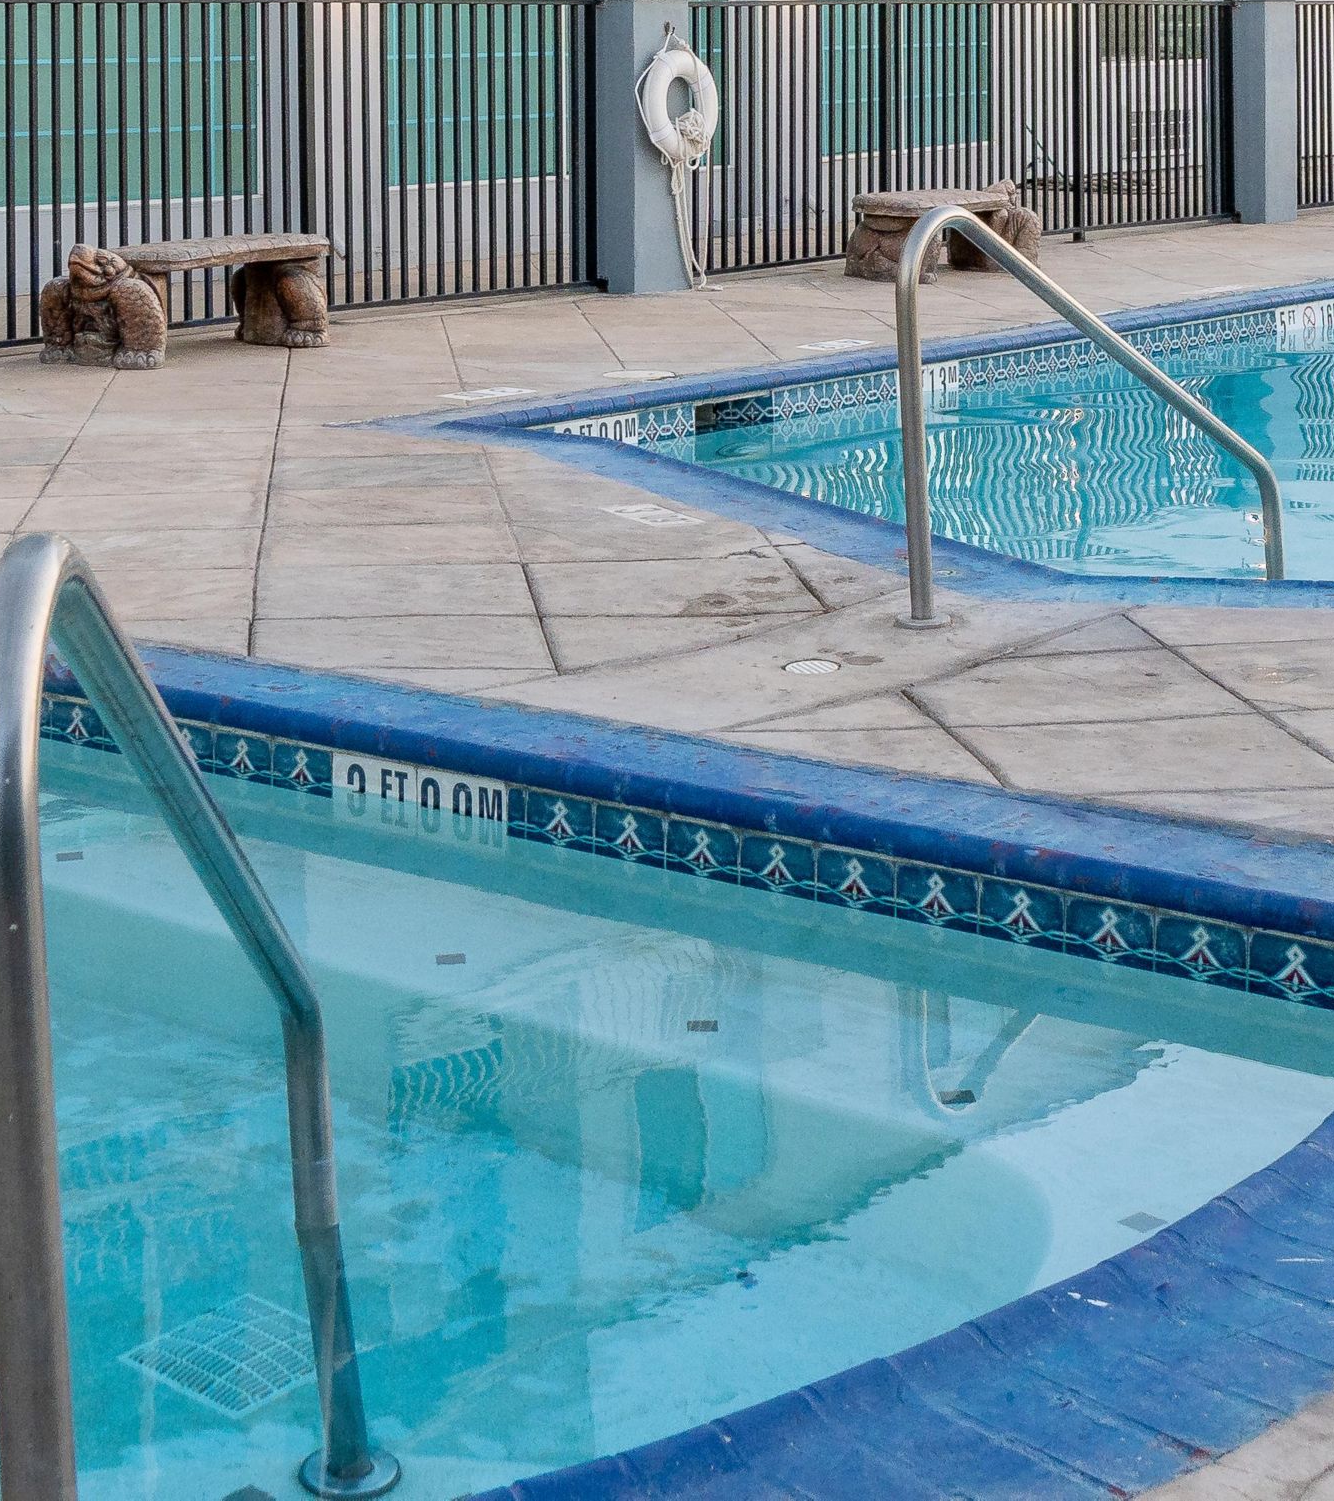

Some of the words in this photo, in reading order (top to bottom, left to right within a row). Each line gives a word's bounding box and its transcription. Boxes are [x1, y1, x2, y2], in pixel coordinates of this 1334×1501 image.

[1279, 311, 1286, 331] 5
[1288, 310, 1296, 324] FT
[381, 768, 409, 802] FT
